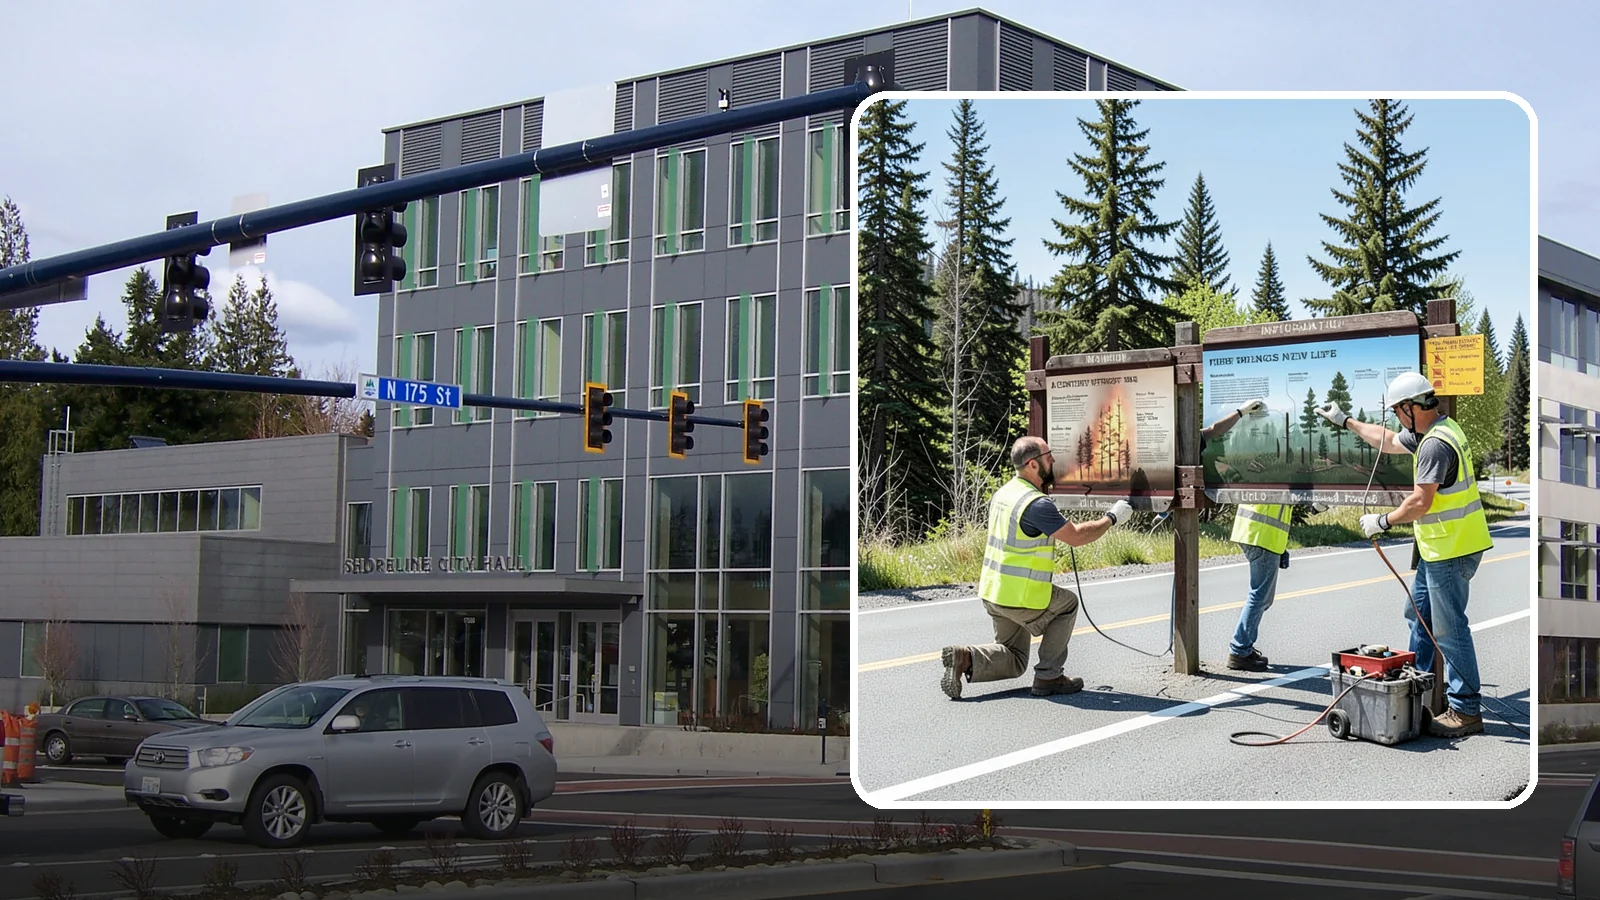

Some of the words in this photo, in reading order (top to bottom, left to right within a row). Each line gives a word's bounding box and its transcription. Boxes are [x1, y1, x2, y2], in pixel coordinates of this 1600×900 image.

[387, 380, 396, 400] N
[405, 382, 428, 403] 175
[436, 386, 452, 406] St
[344, 556, 433, 574] SHORELINE
[438, 556, 476, 573] CITY
[483, 555, 525, 572] HALL
